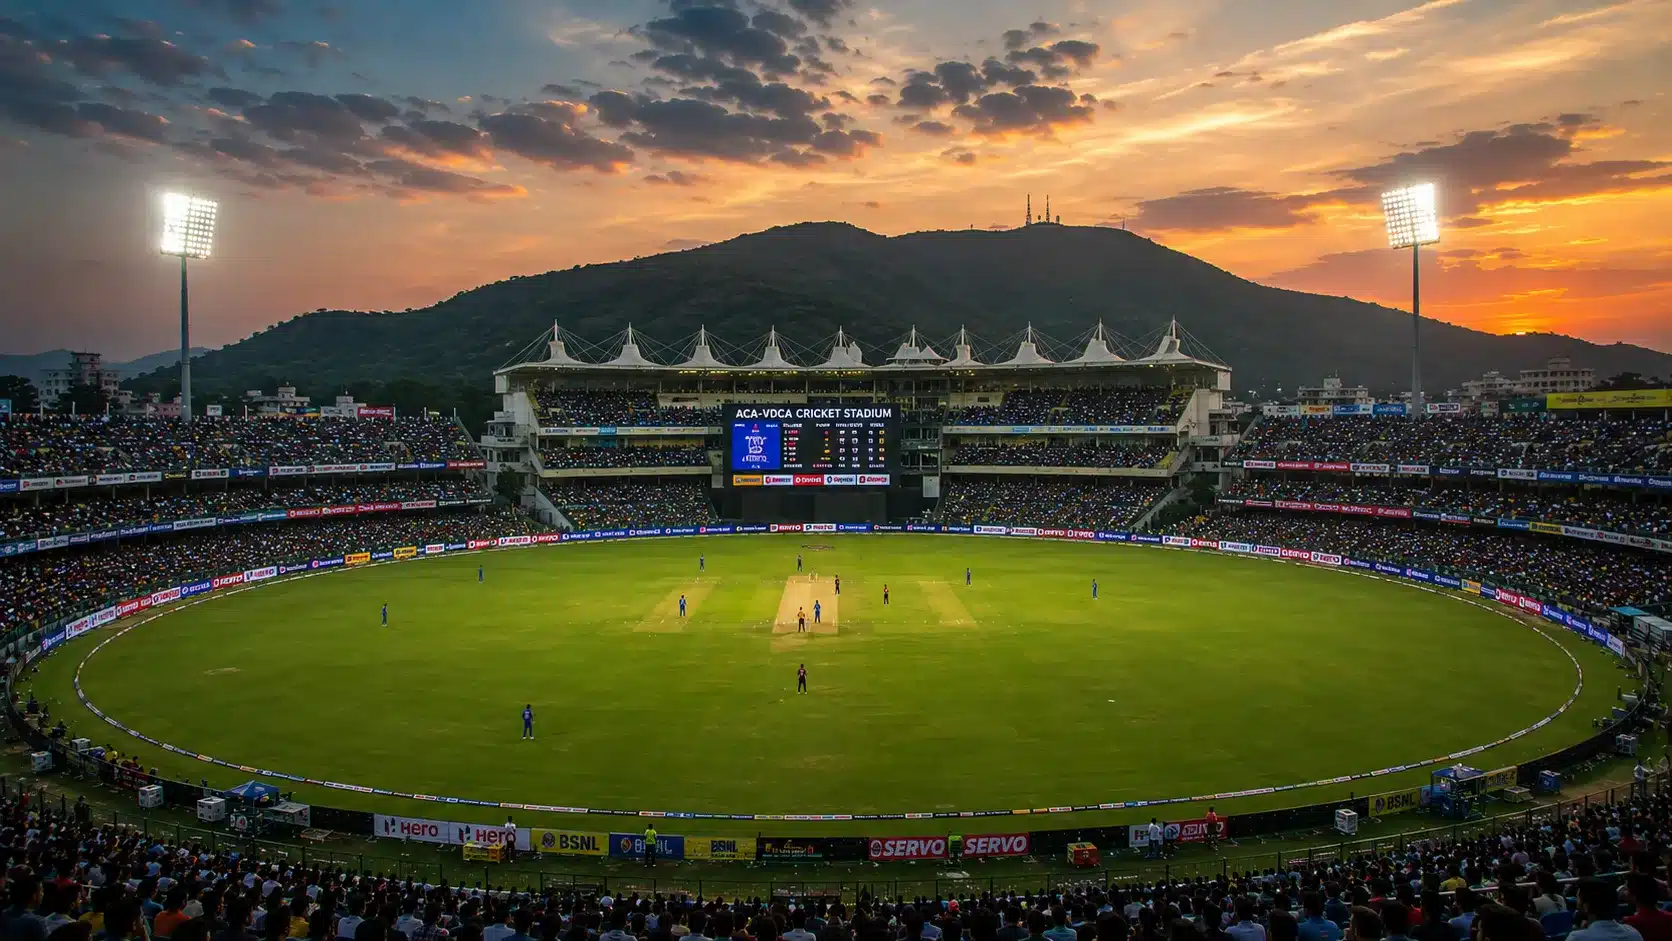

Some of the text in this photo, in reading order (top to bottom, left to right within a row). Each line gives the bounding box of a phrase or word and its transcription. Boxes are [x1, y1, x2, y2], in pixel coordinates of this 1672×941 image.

[735, 408, 892, 419] ACA-VDCA CRICKET STADIUM
[1386, 793, 1415, 810] BSNL
[400, 821, 439, 837] Hero
[559, 834, 600, 851] BSNL
[883, 839, 945, 857] SERVO
[964, 836, 1027, 855] SERVO
